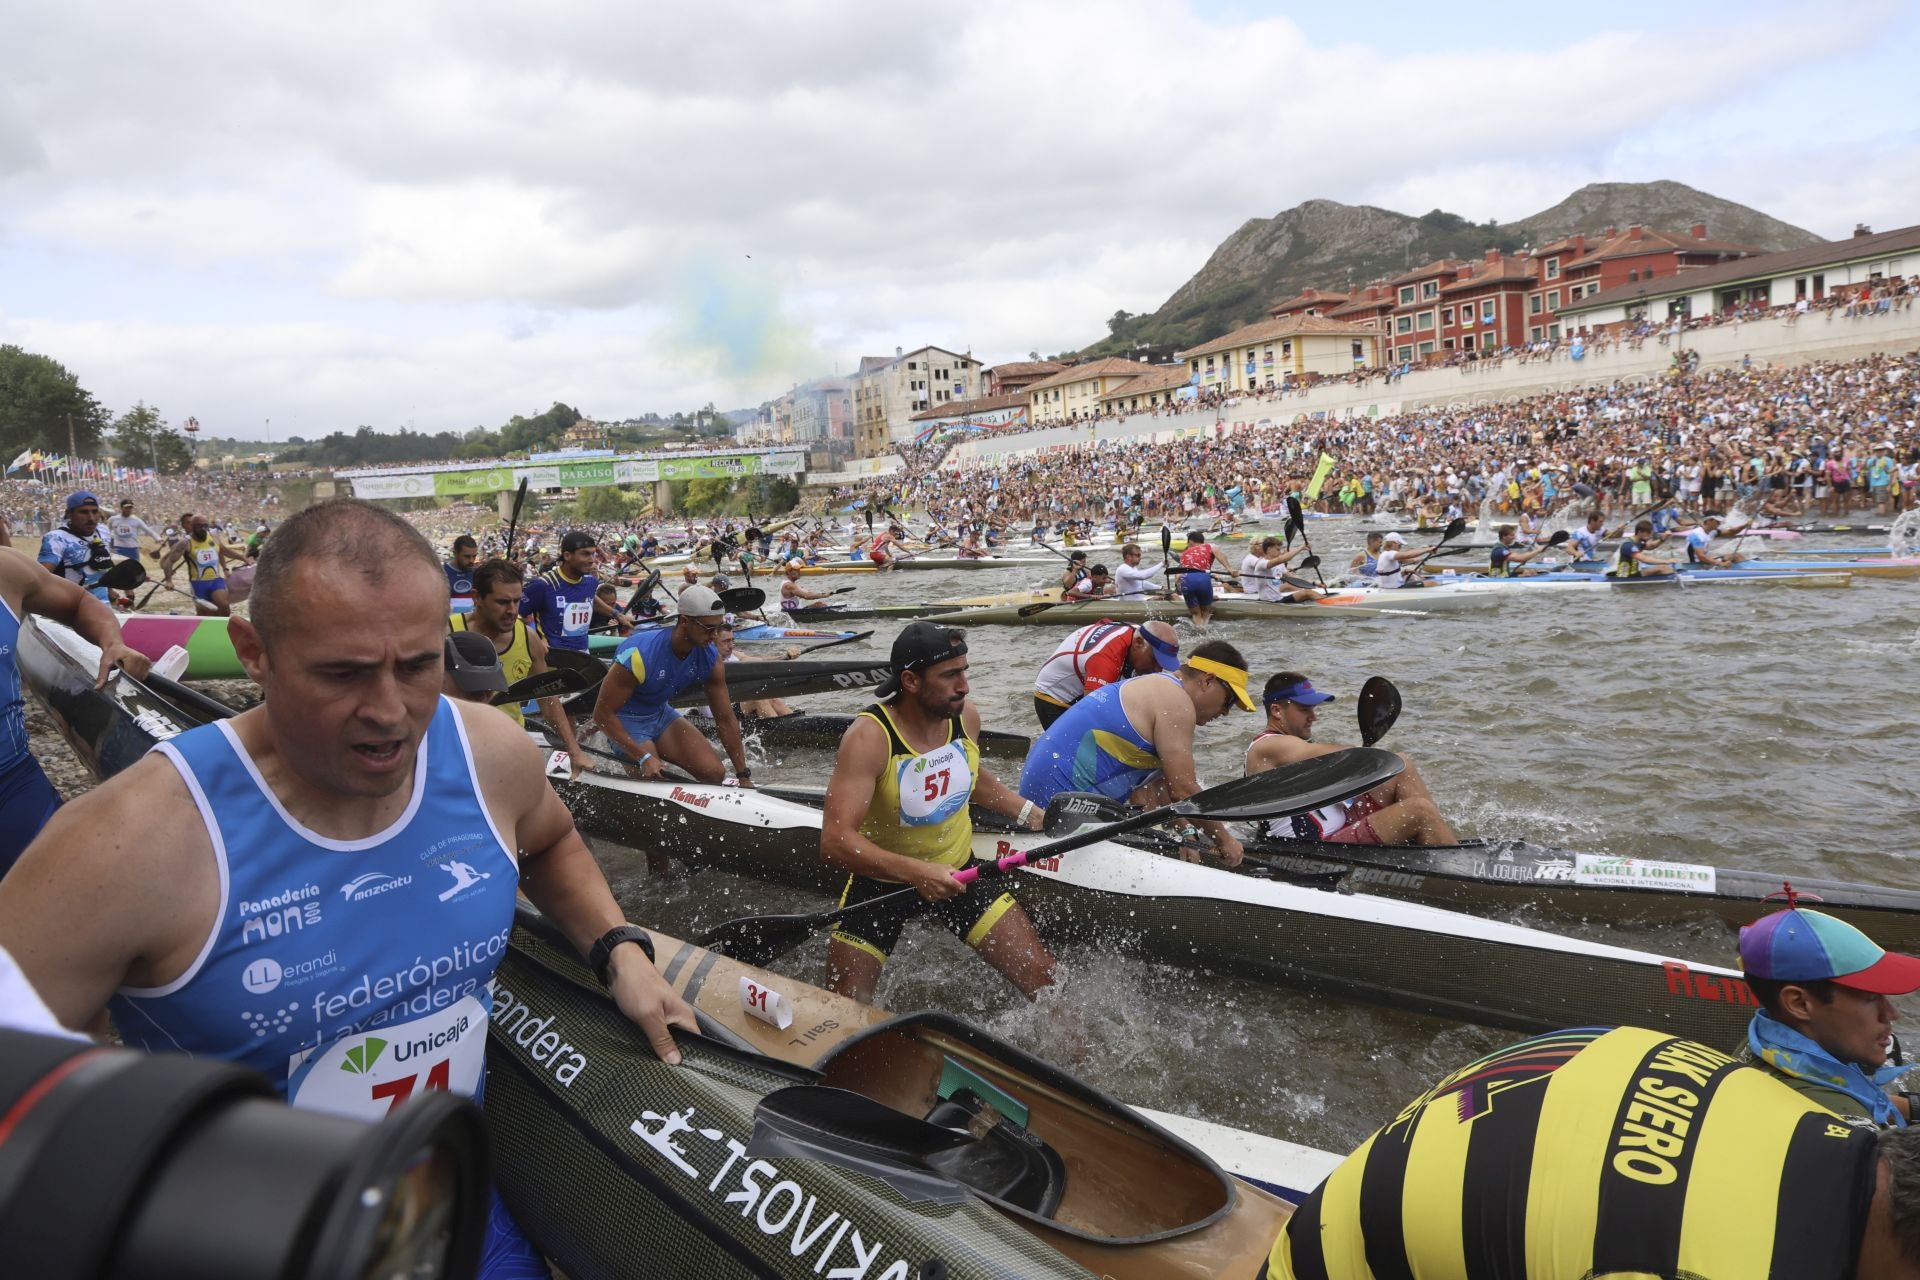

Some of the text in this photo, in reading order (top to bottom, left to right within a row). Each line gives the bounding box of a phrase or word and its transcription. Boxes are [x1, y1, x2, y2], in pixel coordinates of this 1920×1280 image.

[572, 612, 589, 625] 118
[555, 752, 568, 763] 57
[928, 751, 954, 768] Unicaja
[925, 768, 951, 801] 57
[1352, 866, 1425, 889] RACING
[1473, 861, 1534, 882] LA JOGUERA
[1638, 880, 1696, 890] INTERNACIONAL
[312, 928, 508, 1023] federópticos
[747, 984, 768, 1012] 31
[394, 1015, 469, 1063] Unicaja
[1612, 1076, 1700, 1186] SIERO
